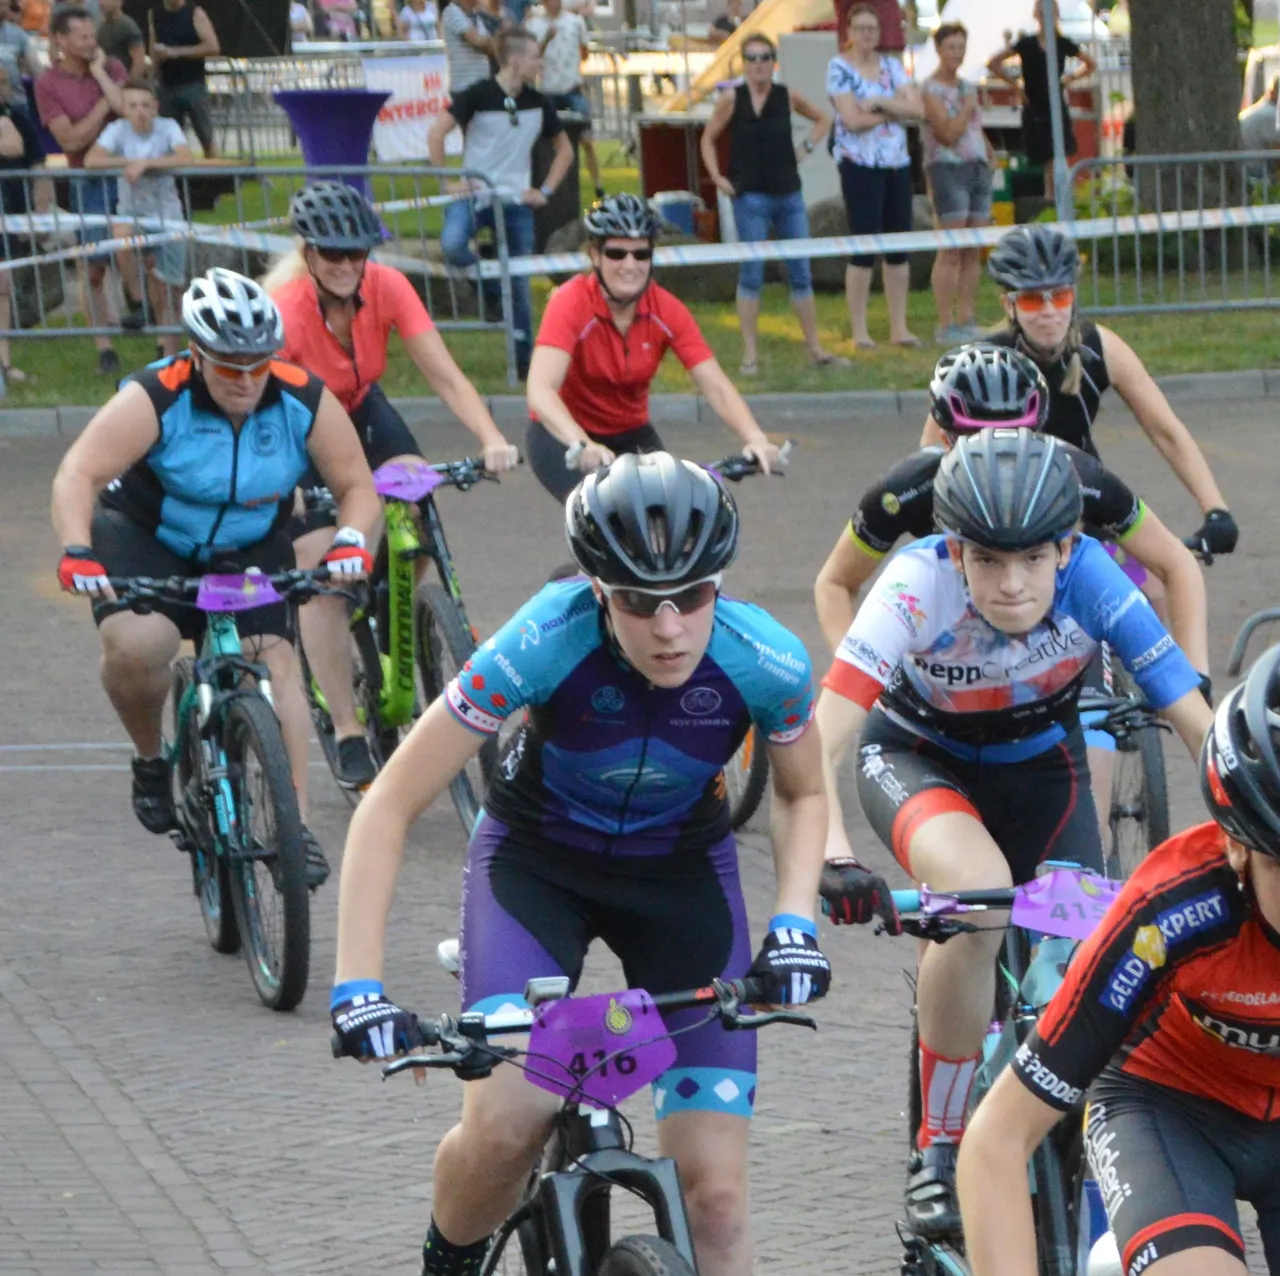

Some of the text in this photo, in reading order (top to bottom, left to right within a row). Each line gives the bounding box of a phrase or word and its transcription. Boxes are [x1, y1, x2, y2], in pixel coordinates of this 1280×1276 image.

[1049, 902, 1107, 922] 415
[1110, 957, 1145, 1011] GELD
[569, 1049, 637, 1079] 416
